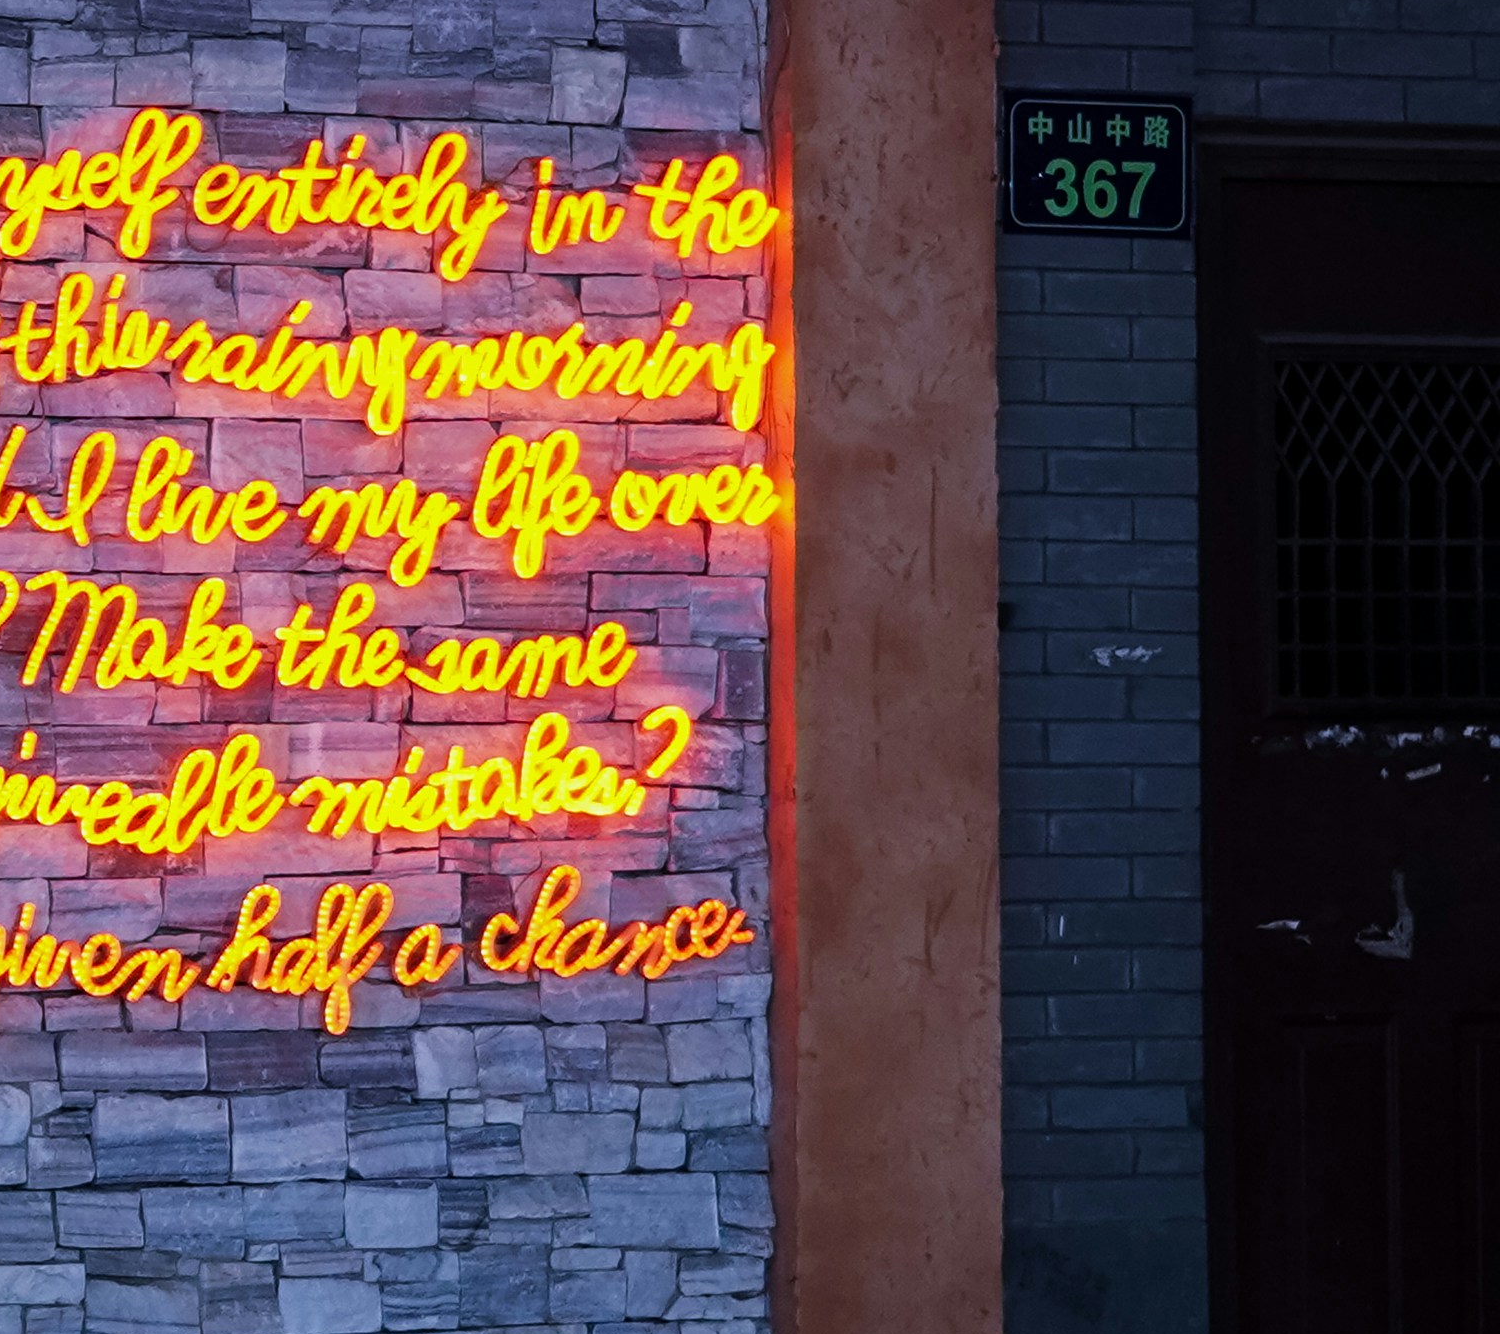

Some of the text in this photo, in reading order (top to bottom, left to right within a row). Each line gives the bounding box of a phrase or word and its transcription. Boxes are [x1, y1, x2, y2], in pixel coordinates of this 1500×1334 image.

[1028, 111, 1170, 148] 中山中路
[1043, 157, 1157, 219] 367
[193, 132, 508, 282] entirely
[530, 157, 625, 255] in
[633, 154, 780, 258] the
[0, 272, 171, 383] this
[163, 300, 416, 436] rainy
[409, 301, 776, 432] morning
[24, 430, 117, 547] I
[125, 435, 288, 545] live
[298, 478, 461, 587] my
[473, 428, 601, 578] life
[609, 463, 782, 532] over
[24, 570, 263, 694] Make
[275, 582, 406, 692] the
[403, 620, 637, 700] same
[203, 882, 394, 1036] half
[392, 923, 465, 987] a
